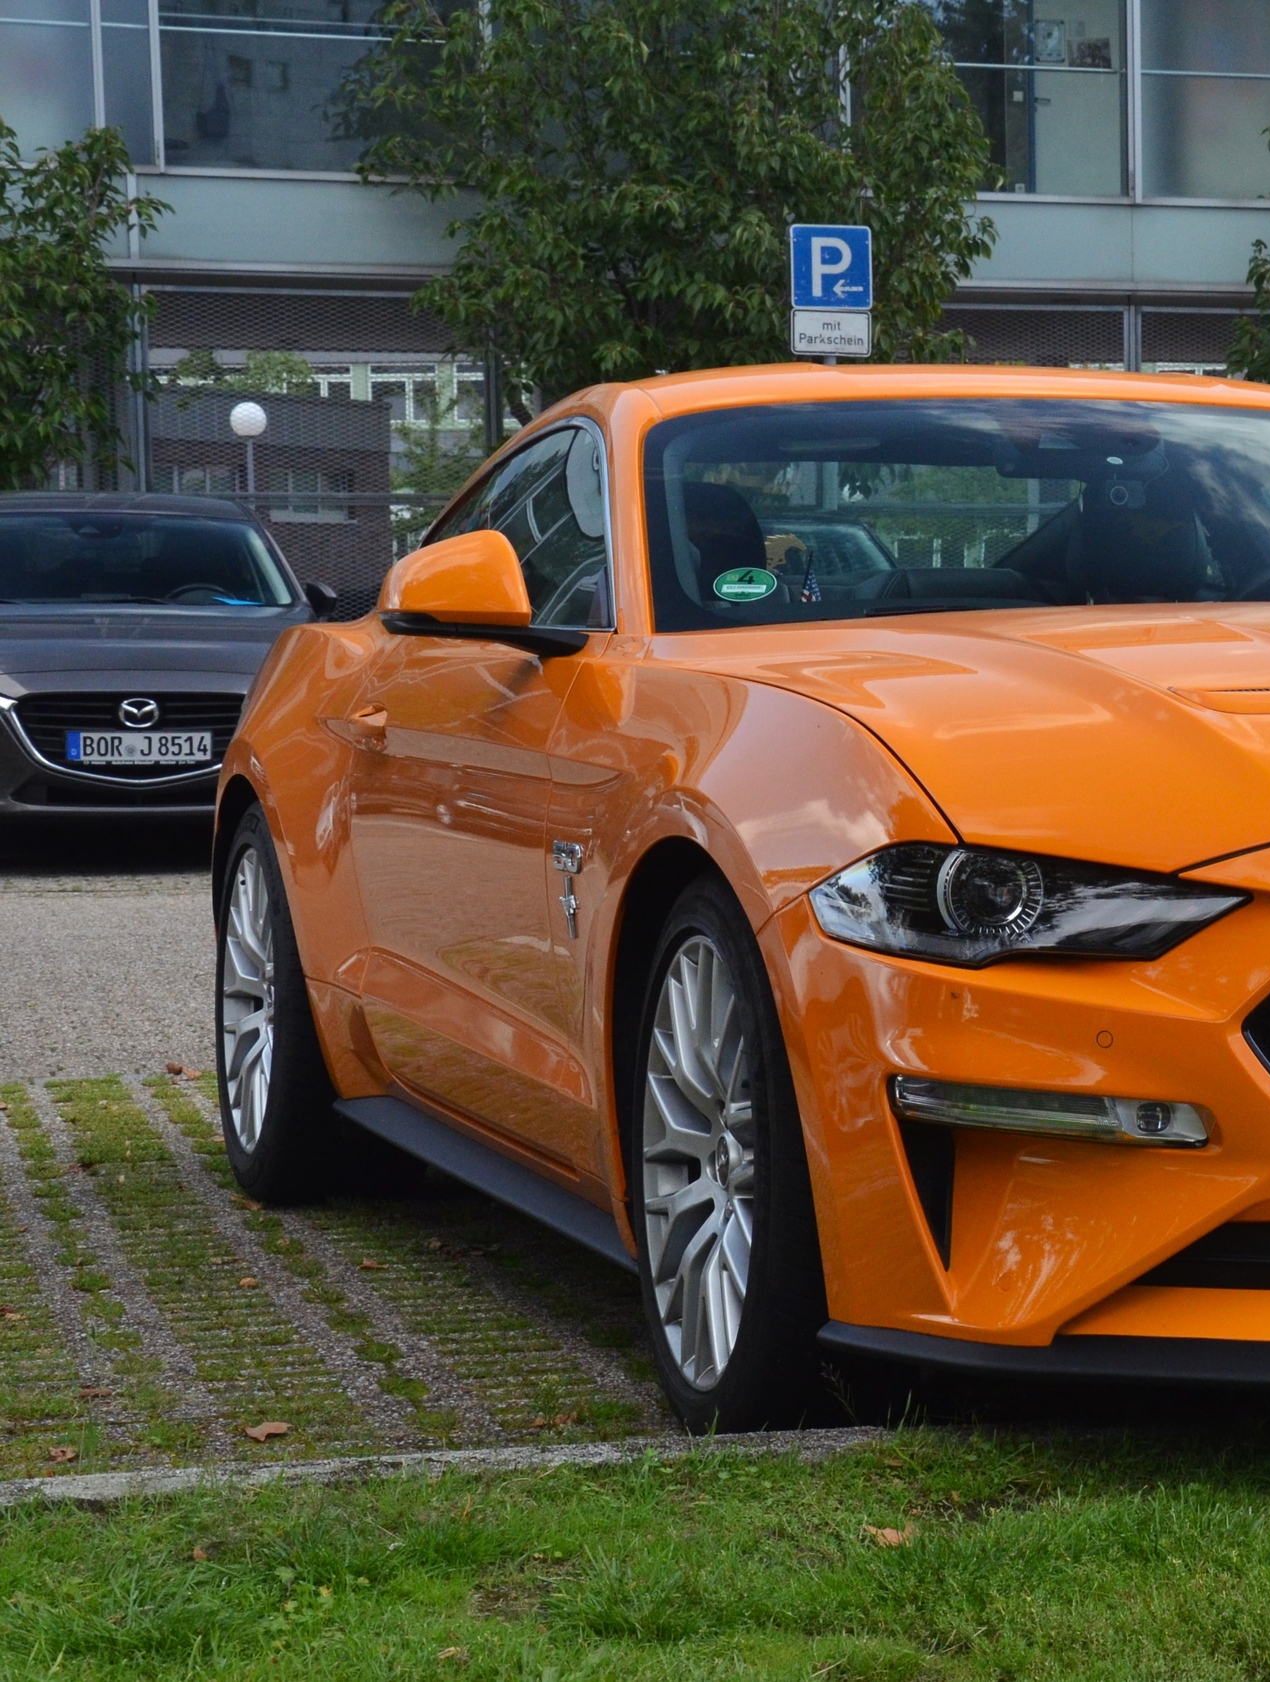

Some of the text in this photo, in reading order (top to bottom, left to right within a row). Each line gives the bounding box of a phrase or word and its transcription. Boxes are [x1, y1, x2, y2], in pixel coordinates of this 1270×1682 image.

[811, 236, 852, 297] P
[822, 322, 842, 331] mit
[798, 333, 864, 346] Parkschein
[737, 569, 755, 584] 4
[82, 735, 208, 757] BOR J 8514
